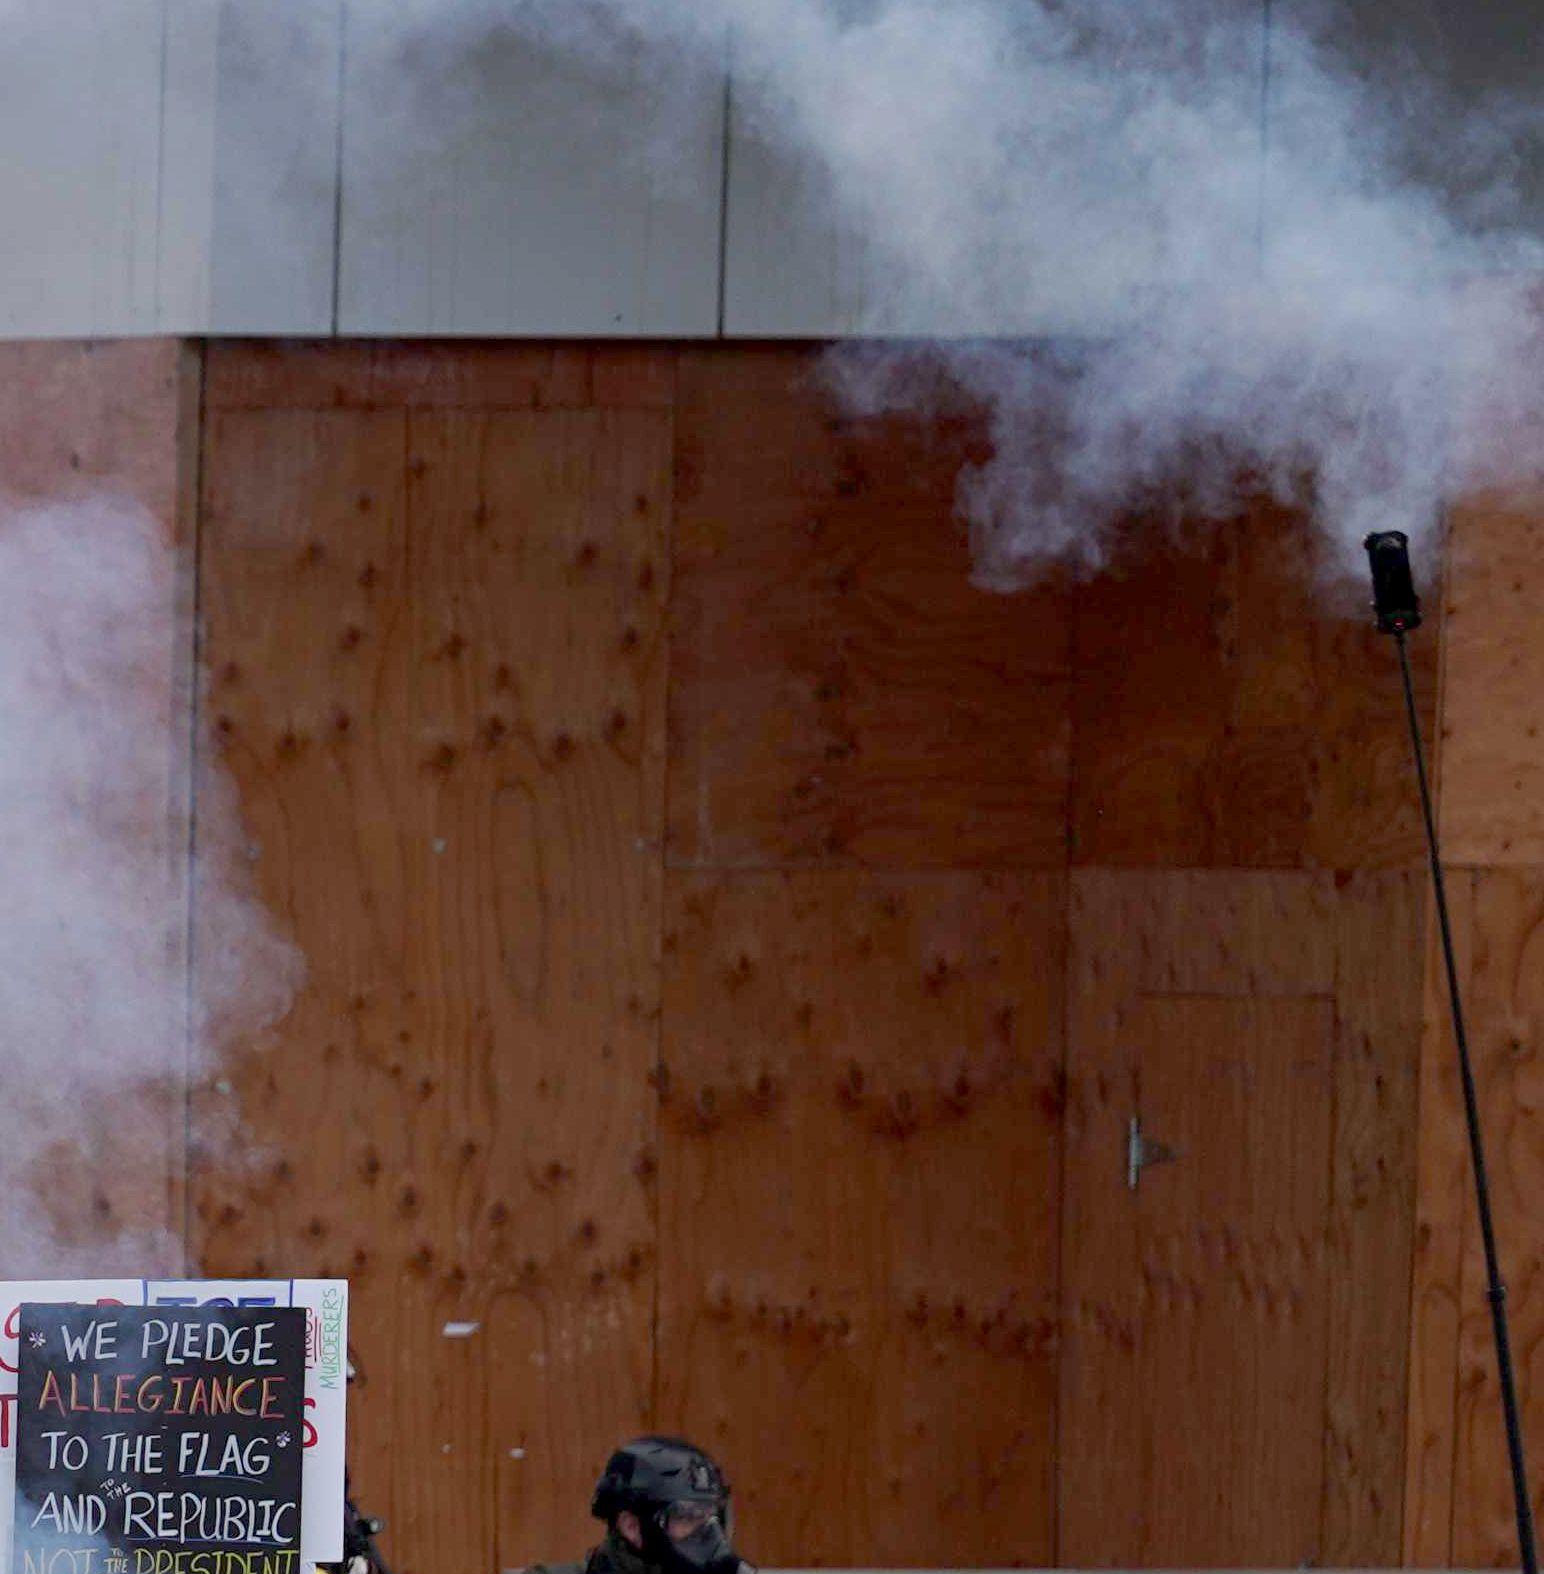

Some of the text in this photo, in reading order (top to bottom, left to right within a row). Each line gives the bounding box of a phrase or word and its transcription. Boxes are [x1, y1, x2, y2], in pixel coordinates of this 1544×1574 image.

[61, 1320, 118, 1362] WE
[142, 1320, 278, 1366] PLEDGE
[319, 1287, 340, 1390] MURDERERS
[38, 1369, 287, 1419] ALLEGIANCE
[41, 1431, 271, 1476] TO THE FLAG
[30, 1491, 107, 1535] AND
[123, 1491, 297, 1544] REPUBLIC
[104, 1556, 129, 1574] THE
